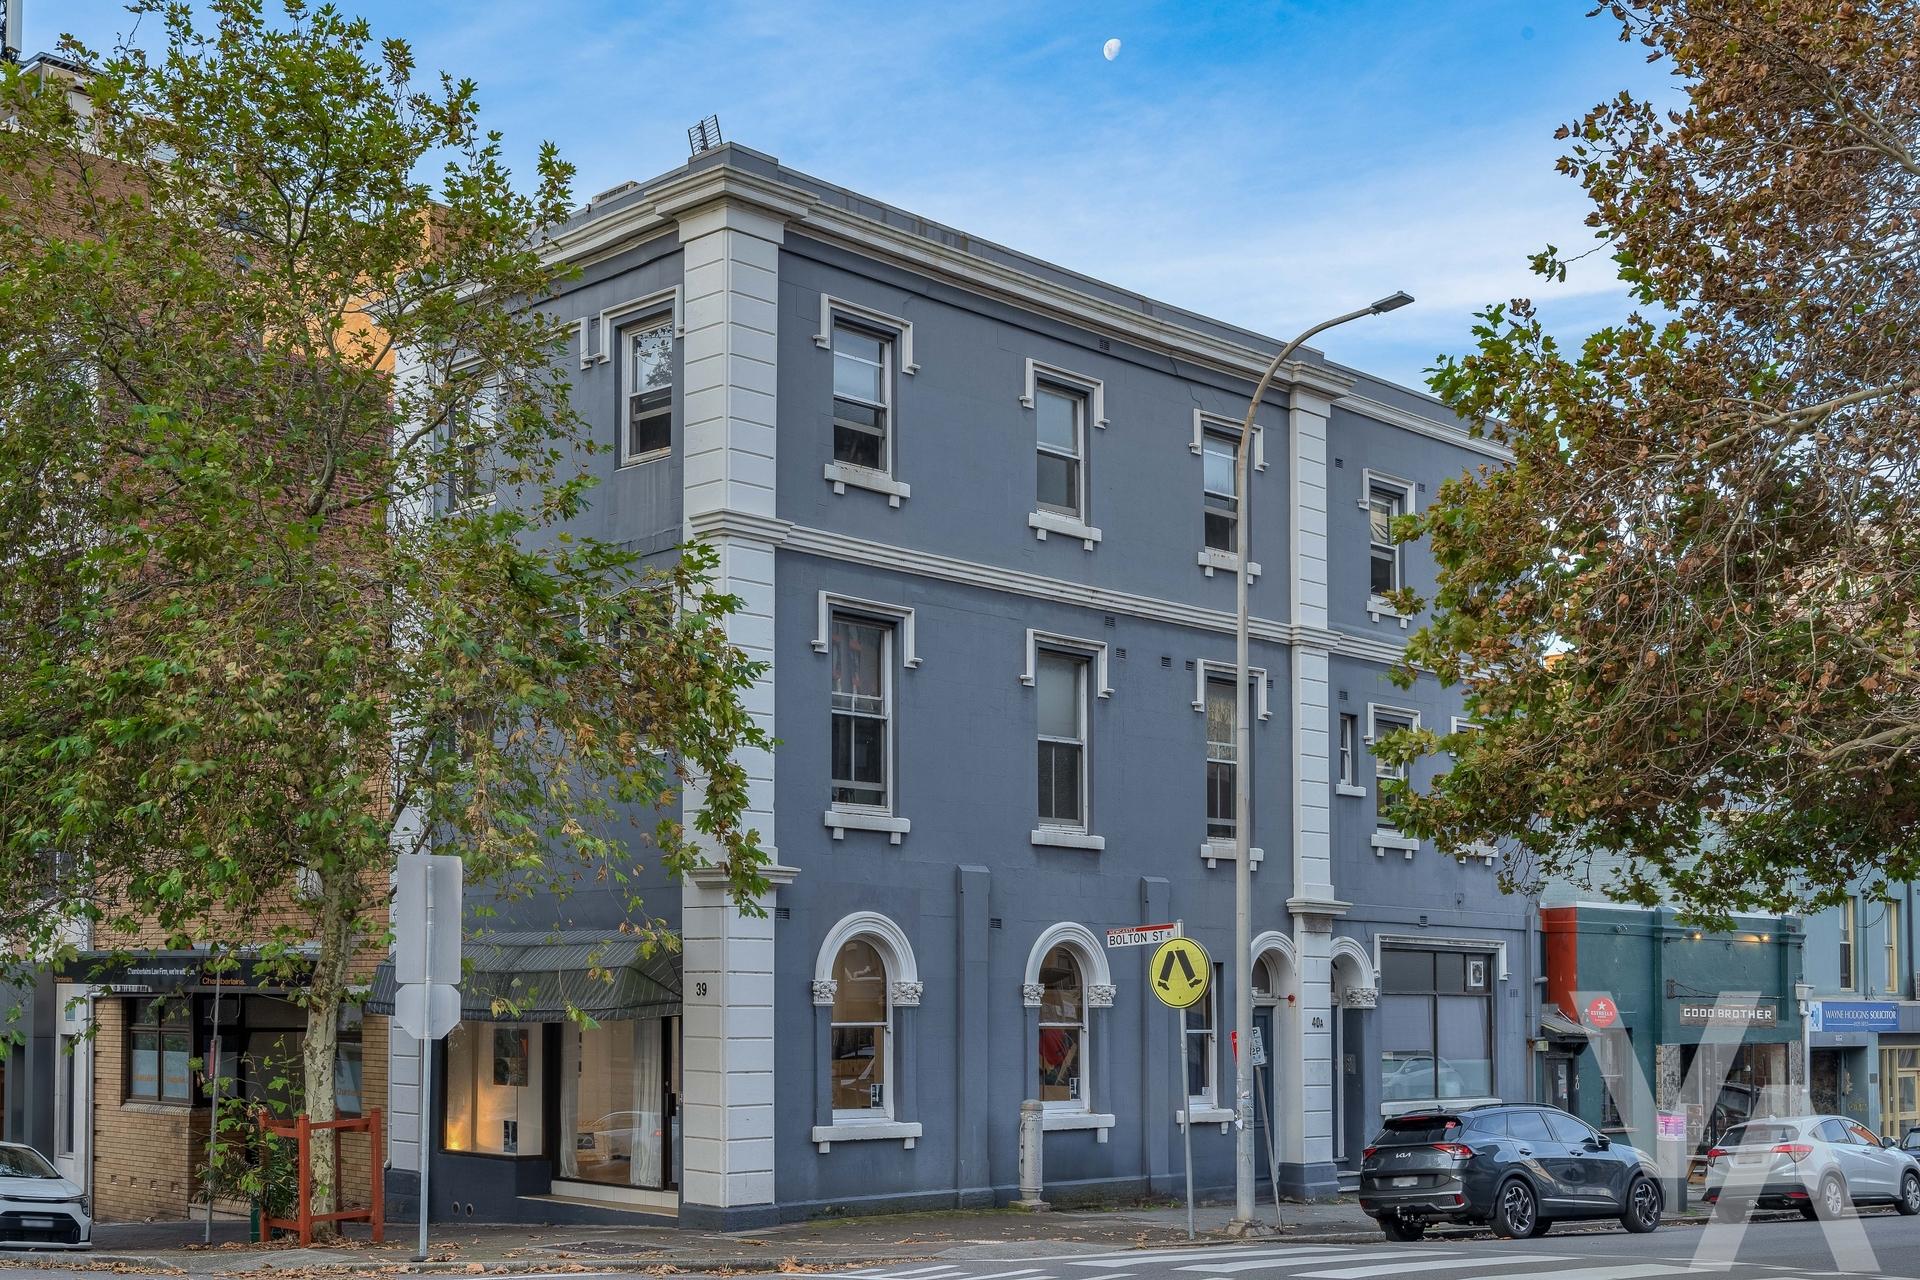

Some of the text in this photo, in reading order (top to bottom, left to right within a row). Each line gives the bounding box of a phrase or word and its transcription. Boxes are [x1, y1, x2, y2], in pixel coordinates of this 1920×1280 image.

[1109, 931, 1164, 946] BOLTON ST
[696, 982, 707, 996] 39
[1683, 1008, 1772, 1020] GOOD BROTHER
[1825, 1010, 1845, 1019] WAYNE
[1870, 1010, 1896, 1020] SOLICITOR
[1311, 1017, 1324, 1028] 40A
